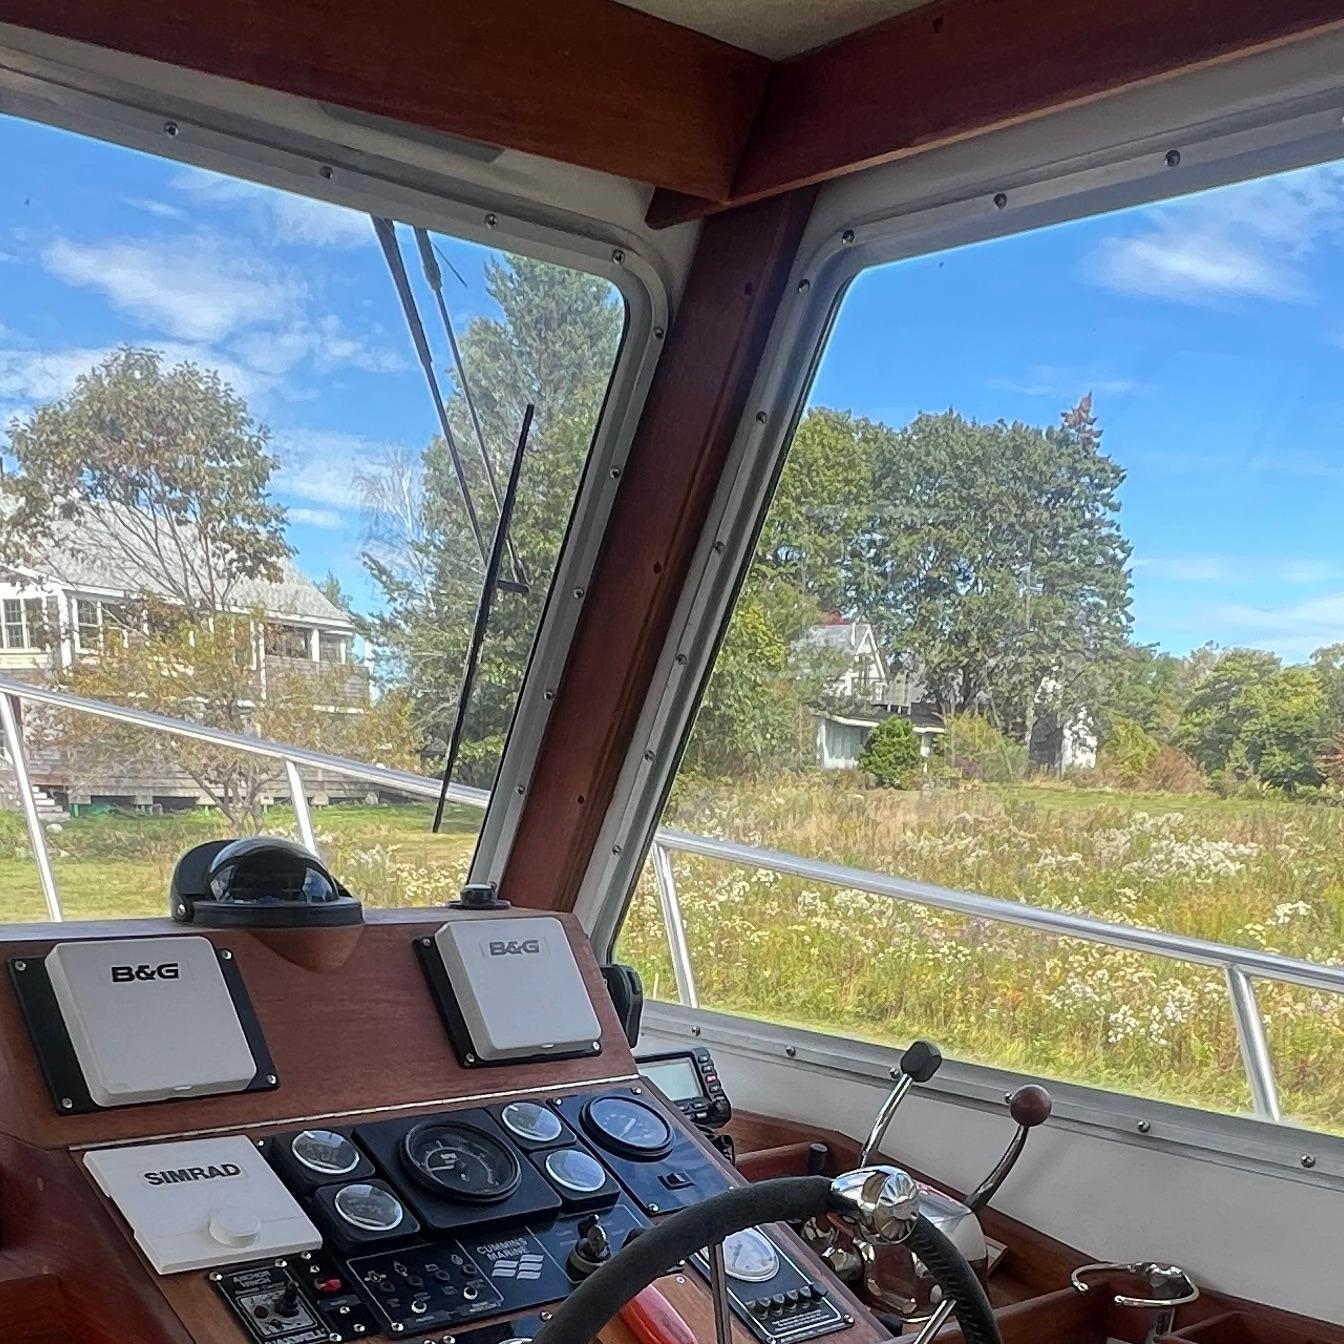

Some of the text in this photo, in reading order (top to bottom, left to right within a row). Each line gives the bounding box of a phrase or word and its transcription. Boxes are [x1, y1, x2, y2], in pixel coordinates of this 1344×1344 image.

[489, 939, 540, 956] B&G
[111, 962, 180, 983] B&G
[144, 1163, 242, 1186] SIMRAD
[476, 1237, 528, 1255] CUMMINS
[486, 1245, 530, 1261] MARINE
